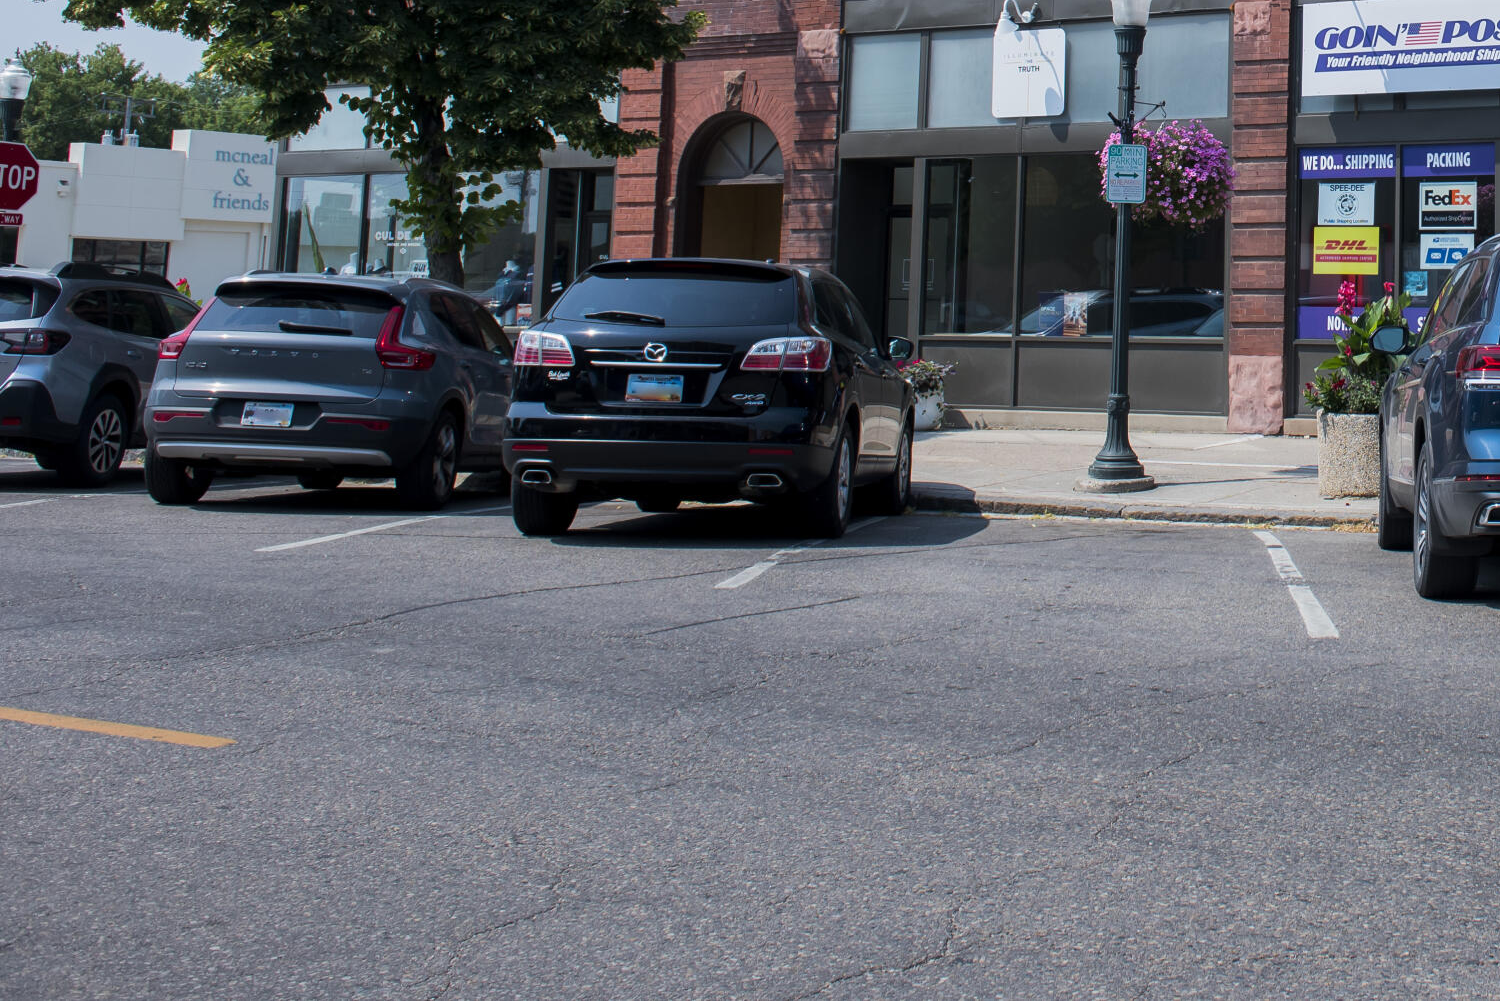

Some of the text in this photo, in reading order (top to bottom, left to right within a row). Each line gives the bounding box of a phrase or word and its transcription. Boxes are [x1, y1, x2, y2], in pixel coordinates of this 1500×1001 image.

[1315, 23, 1408, 50] GOIN'
[1326, 55, 1350, 68] Your
[1351, 52, 1395, 67] Friendly
[1397, 49, 1474, 65] Neighborhood
[215, 148, 274, 166] mcneal
[1110, 147, 1143, 157] 90 MIN
[1426, 152, 1471, 168] PACKING
[1111, 157, 1144, 166] PARKING
[1303, 154, 1394, 170] WE DO... SHIPPING
[232, 167, 252, 187] &
[1329, 184, 1365, 192] SPEE-DEE
[212, 190, 270, 211] friends
[1424, 189, 1472, 206] FedEx
[375, 231, 394, 240] CUL
[1325, 240, 1368, 250] DHL
